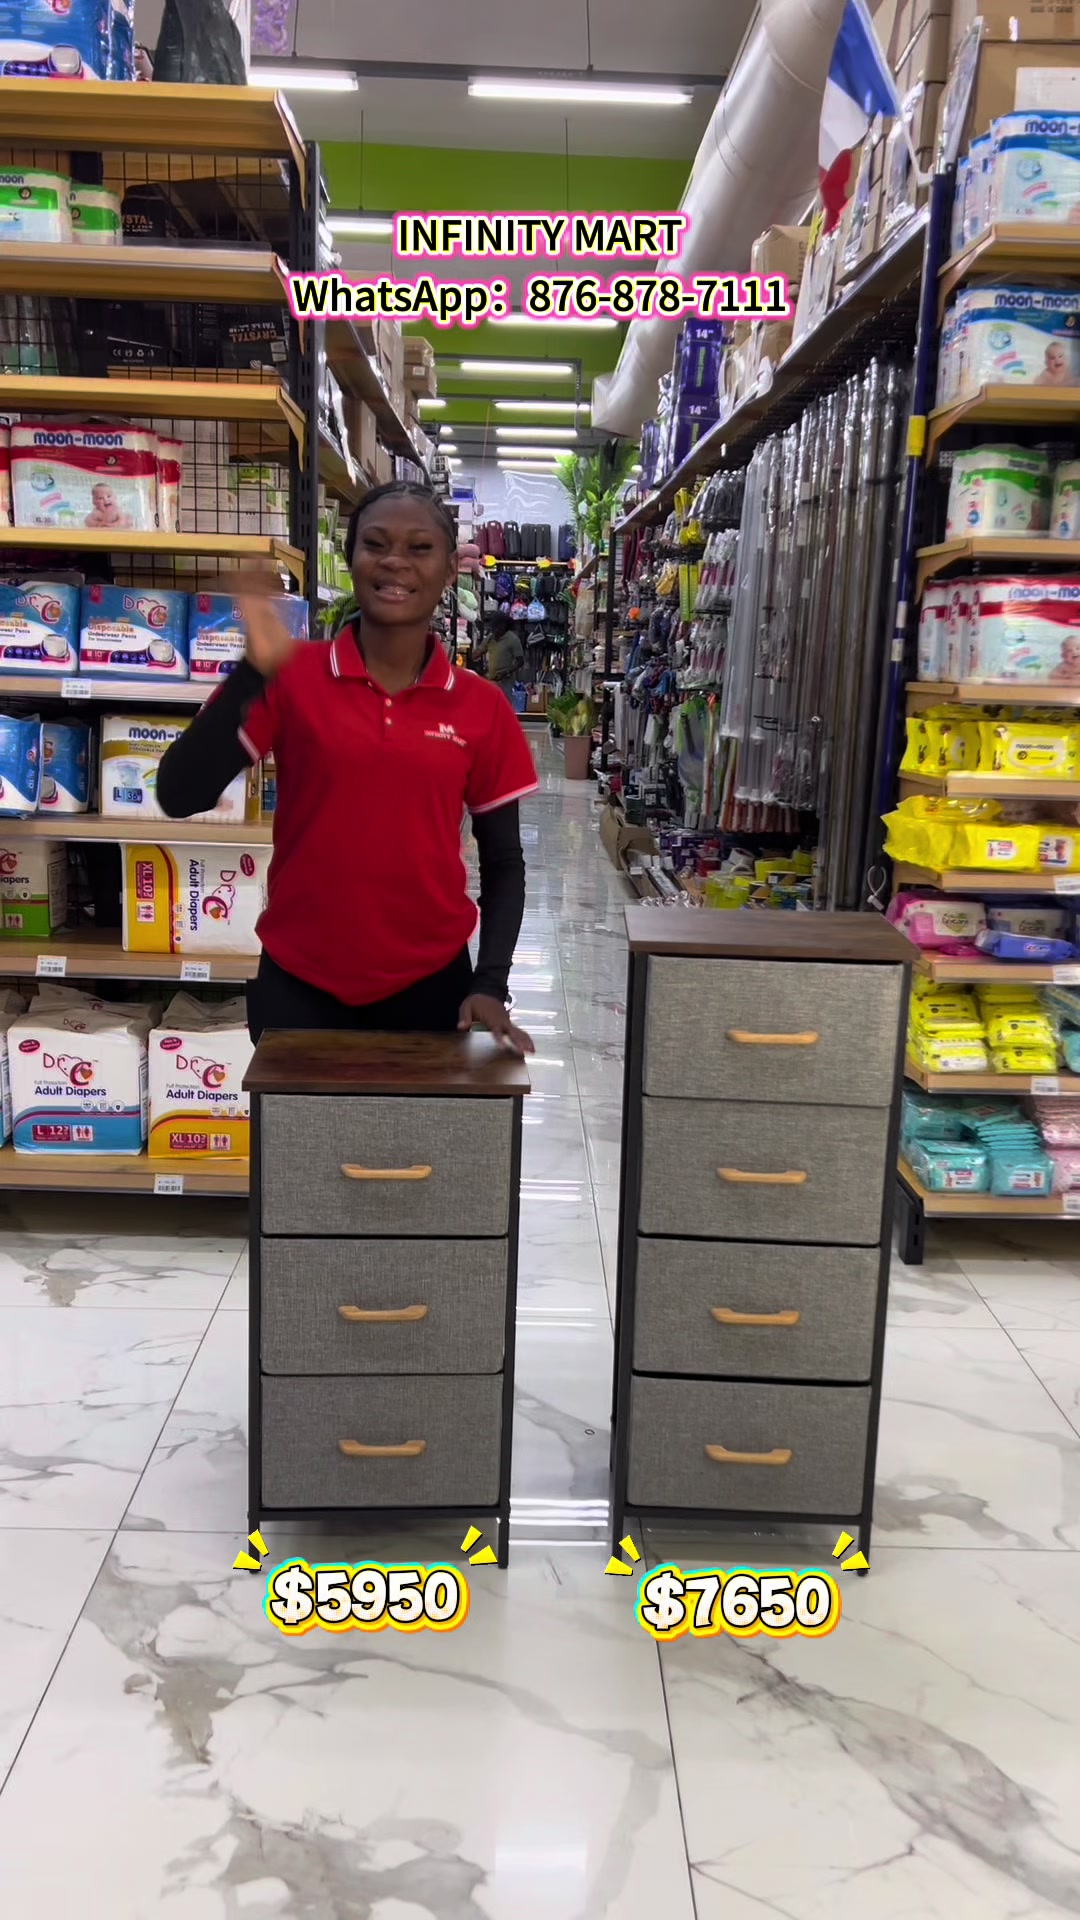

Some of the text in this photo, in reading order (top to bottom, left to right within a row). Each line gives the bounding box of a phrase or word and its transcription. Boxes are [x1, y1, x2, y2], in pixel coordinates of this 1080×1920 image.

[1024, 119, 1080, 135] moon-
[994, 293, 1079, 309] moon-moon
[33, 431, 123, 446] moon-moon
[116, 789, 138, 801] L 36
[188, 859, 200, 932] Adult Diapers
[34, 1086, 107, 1098] Adult Diapers
[166, 1089, 239, 1102] Adult Diapers
[37, 1125, 44, 1135] L
[171, 1133, 185, 1143] XL
